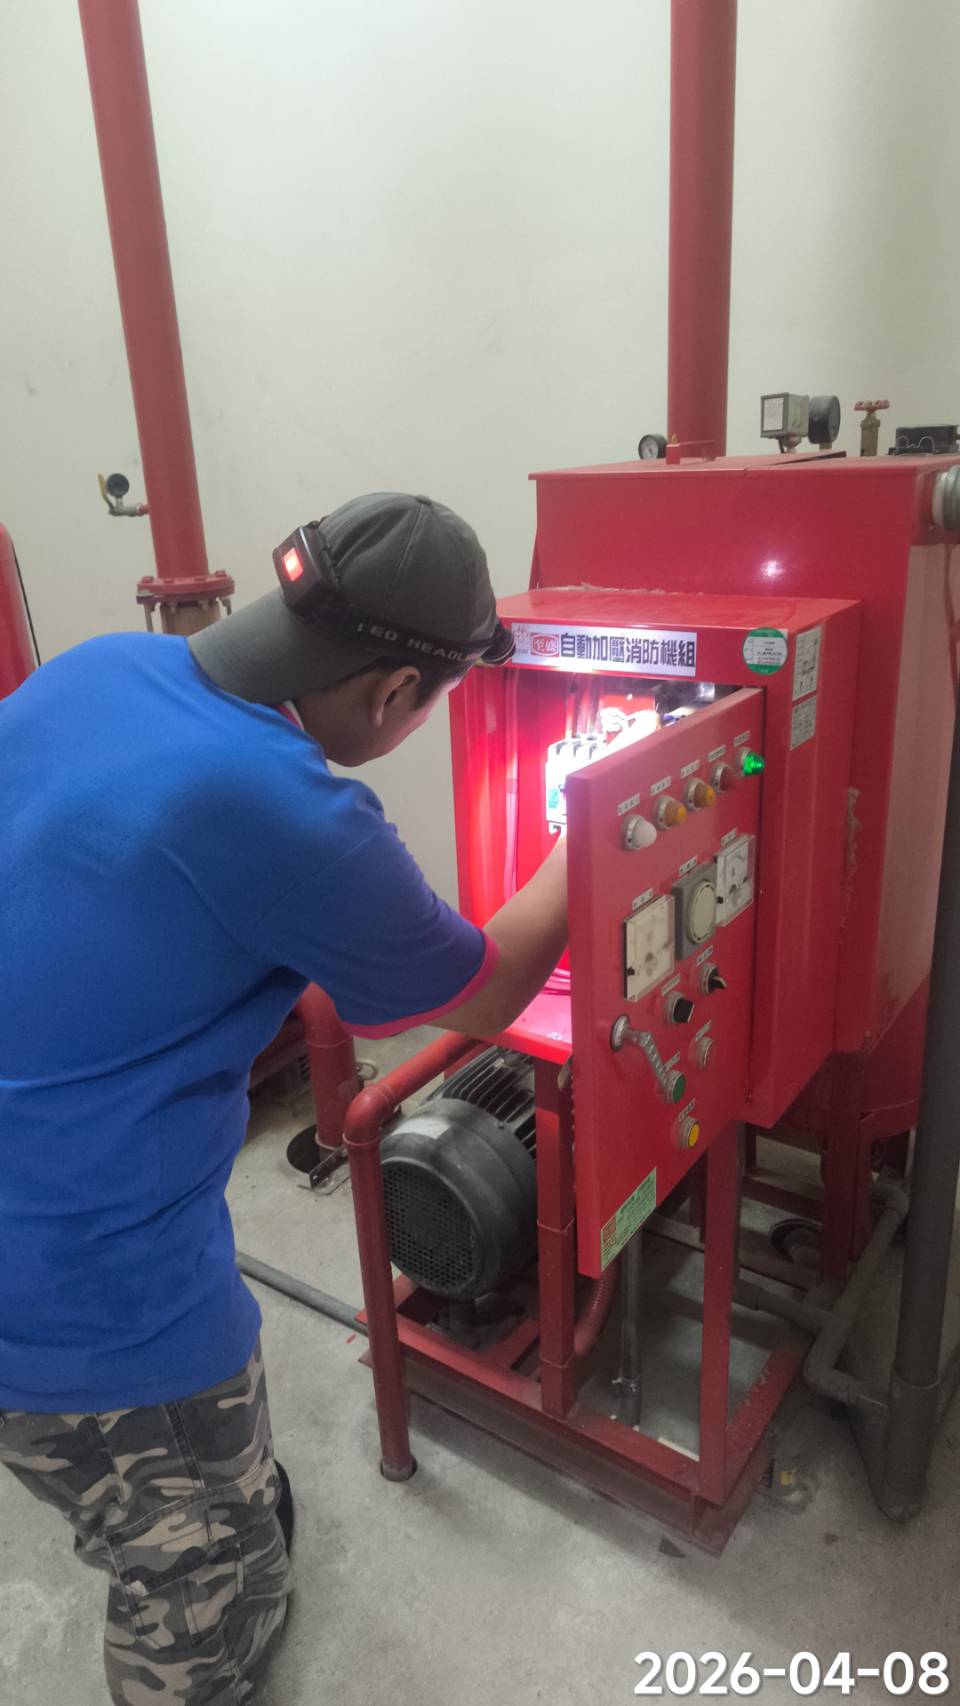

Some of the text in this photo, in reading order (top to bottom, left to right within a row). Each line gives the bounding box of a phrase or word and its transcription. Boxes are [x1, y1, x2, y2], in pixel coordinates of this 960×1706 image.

[560, 632, 696, 668] 自動加壓消防機組
